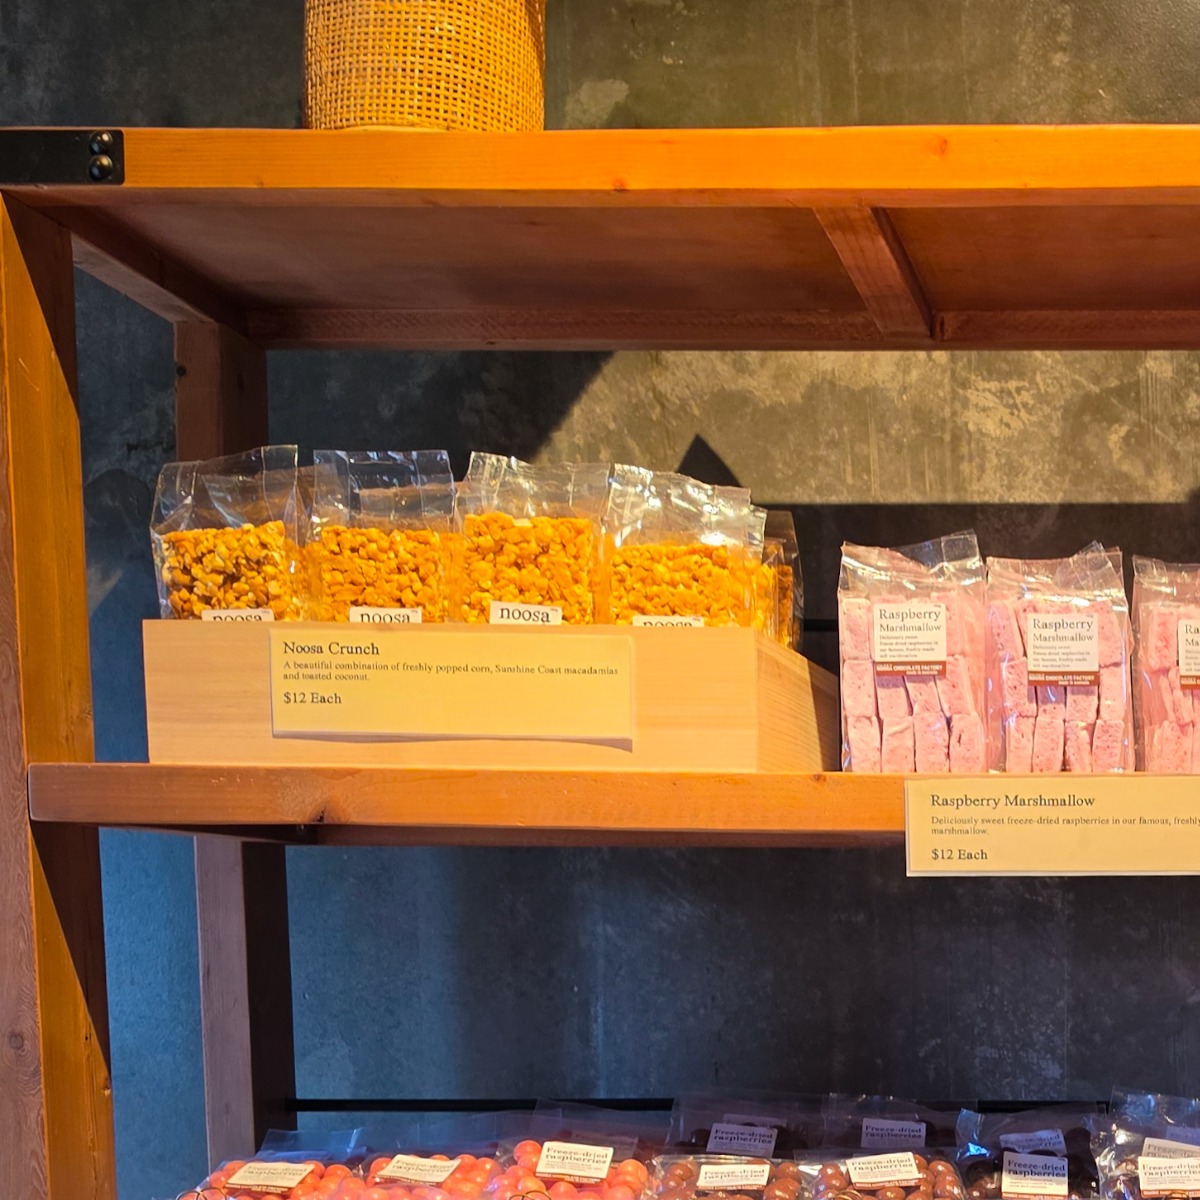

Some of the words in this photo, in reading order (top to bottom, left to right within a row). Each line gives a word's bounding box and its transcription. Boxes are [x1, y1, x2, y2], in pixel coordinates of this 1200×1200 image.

[499, 607, 550, 625] noosa
[879, 608, 941, 622] Raspberry
[879, 623, 941, 632] Marshmallow
[282, 641, 324, 654] Noosa
[328, 641, 380, 655] Crunch
[283, 660, 291, 669] A
[293, 660, 332, 673] beautiful
[334, 661, 388, 670] combination
[390, 662, 400, 671] of
[402, 662, 433, 674] freshly
[435, 663, 469, 674] popped
[495, 664, 535, 674] Sunshine
[537, 665, 561, 674] Coast
[564, 666, 618, 675] macadamias
[283, 671, 300, 680] and
[302, 671, 332, 680] toasted
[283, 691, 306, 704] $12
[310, 692, 342, 704] Each
[930, 794, 1000, 810] Raspberry
[1004, 794, 1095, 807] Marshmallow
[931, 816, 979, 827] Deliciously
[1007, 815, 1059, 825] freeze-dried
[1062, 816, 1109, 826] raspberries
[1112, 816, 1120, 824] in
[931, 848, 953, 860] $12
[957, 848, 988, 860] Each
